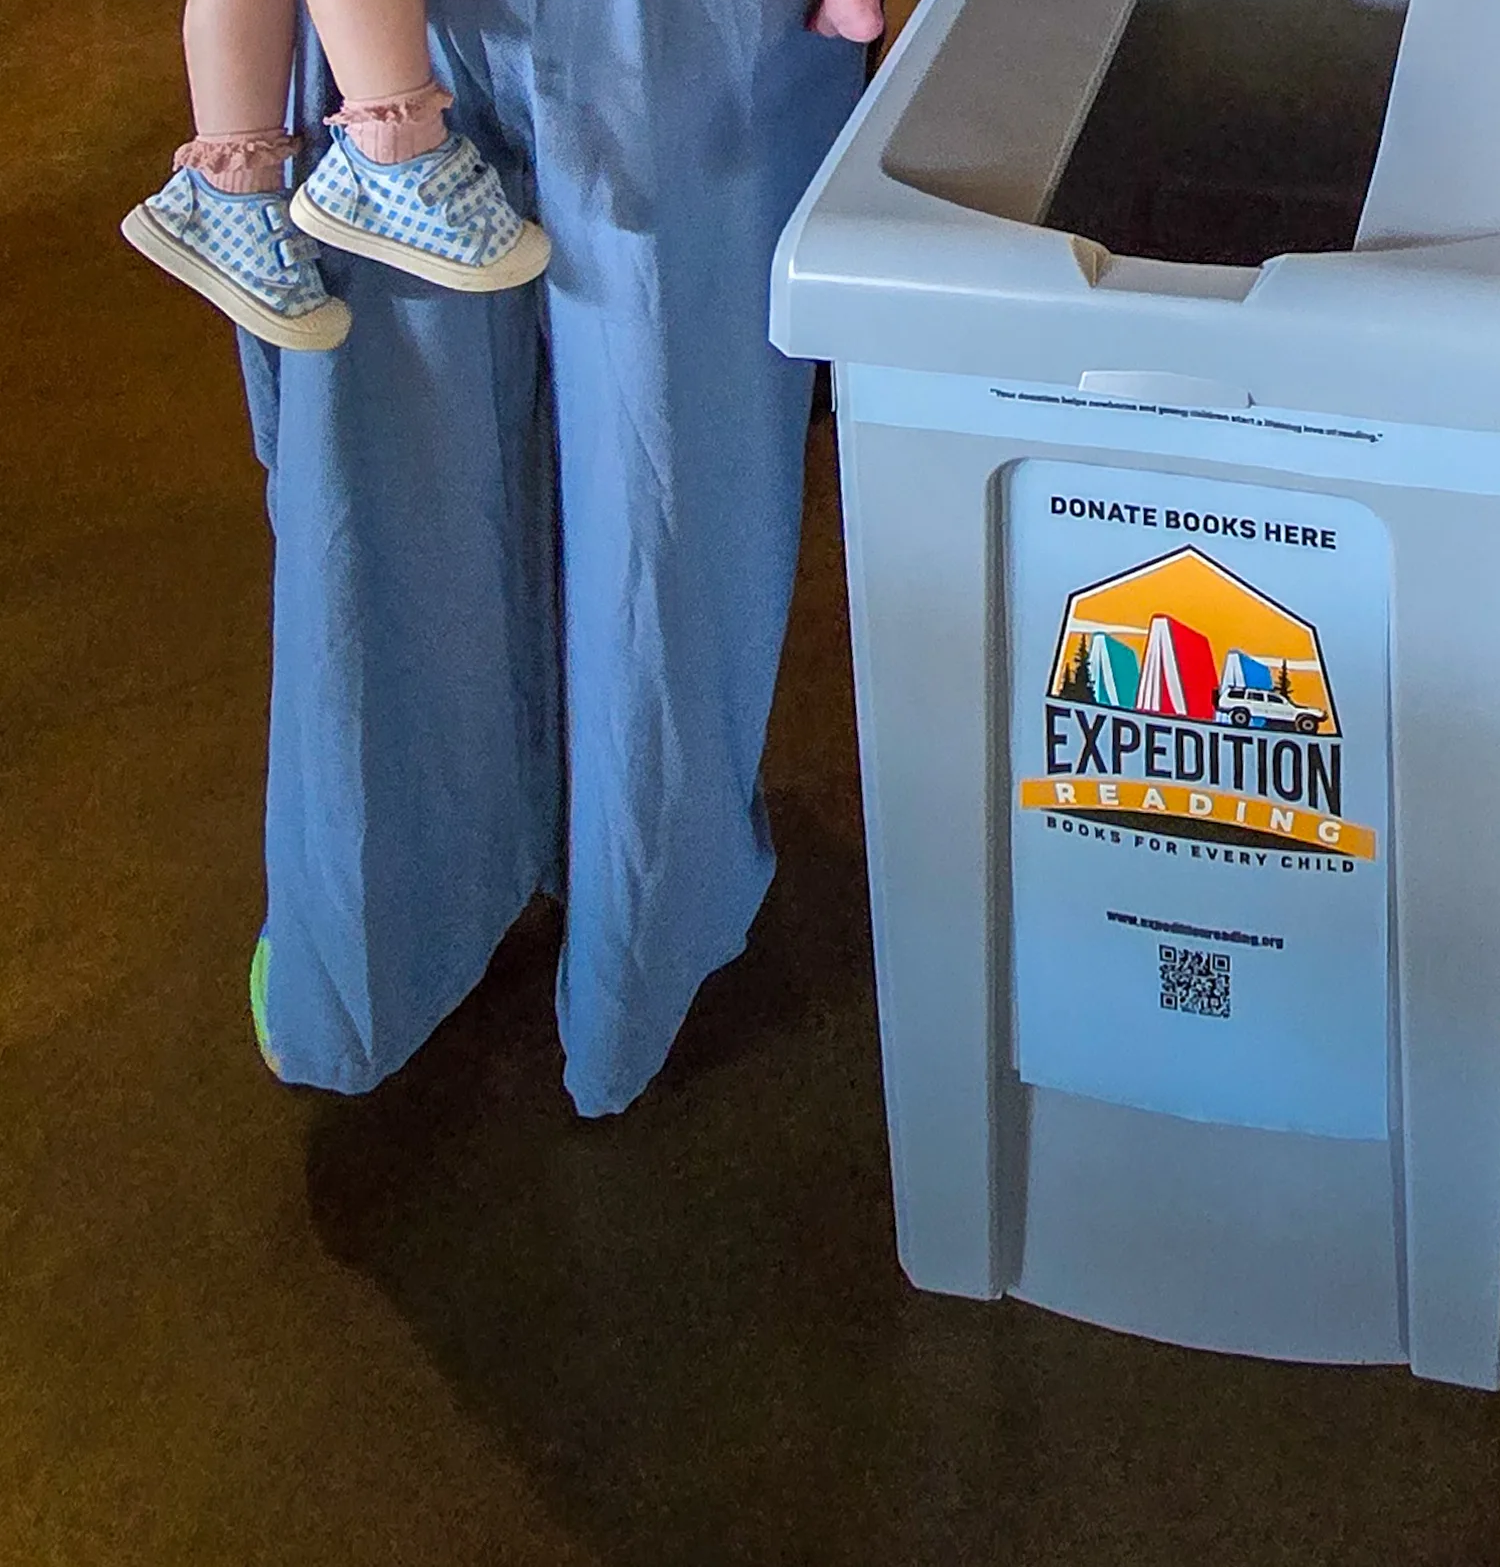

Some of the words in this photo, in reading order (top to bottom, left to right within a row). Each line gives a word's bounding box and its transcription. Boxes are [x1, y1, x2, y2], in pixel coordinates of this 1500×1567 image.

[1050, 496, 1158, 527] DONATE
[1165, 510, 1257, 539] BOOKS
[1264, 522, 1337, 550] HERE
[1045, 703, 1341, 818] EXPEDITION
[1055, 783, 1342, 844] READING
[1047, 815, 1121, 844] BOOKS
[1134, 833, 1178, 856] FOR
[1191, 845, 1267, 867] EVERY
[1281, 855, 1356, 874] CHILD
